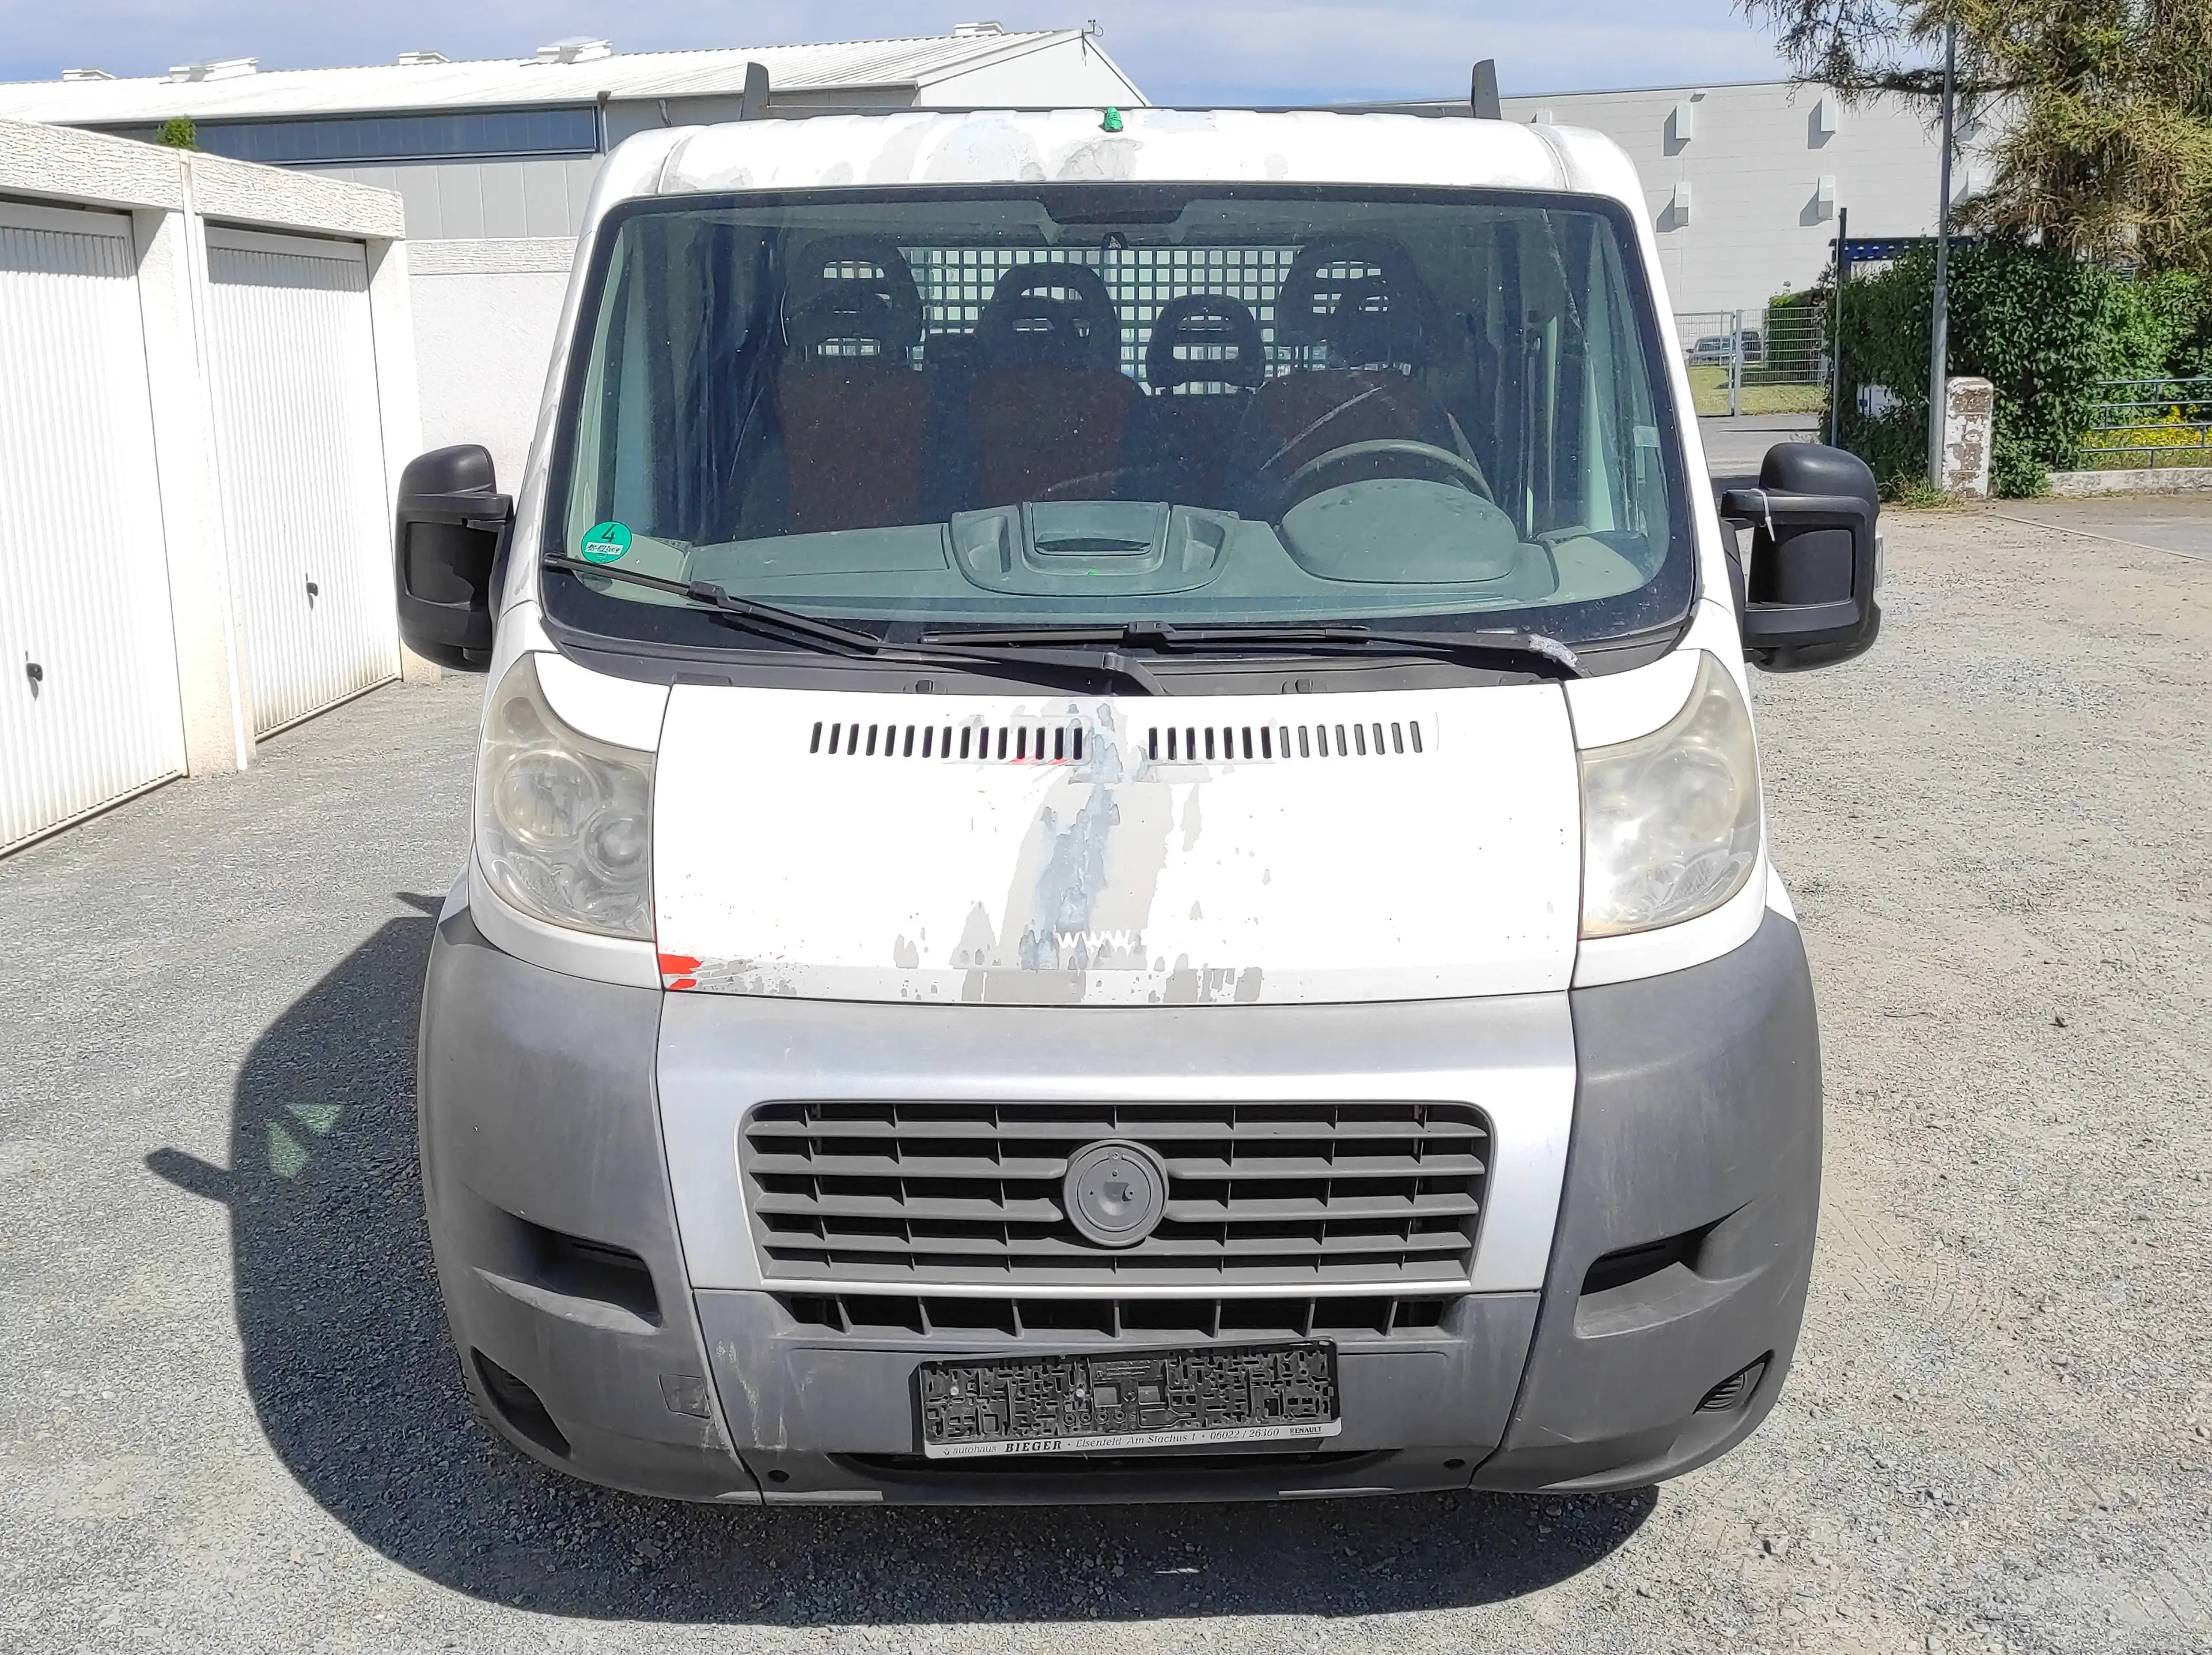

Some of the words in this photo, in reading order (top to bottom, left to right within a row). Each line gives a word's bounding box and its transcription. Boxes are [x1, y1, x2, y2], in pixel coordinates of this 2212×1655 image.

[601, 524, 616, 542] 4
[1005, 1441, 1062, 1452] BIEGER
[1075, 1437, 1122, 1447] Elsenfeld
[1126, 1436, 1144, 1445] Am
[1147, 1434, 1188, 1444] Stachus
